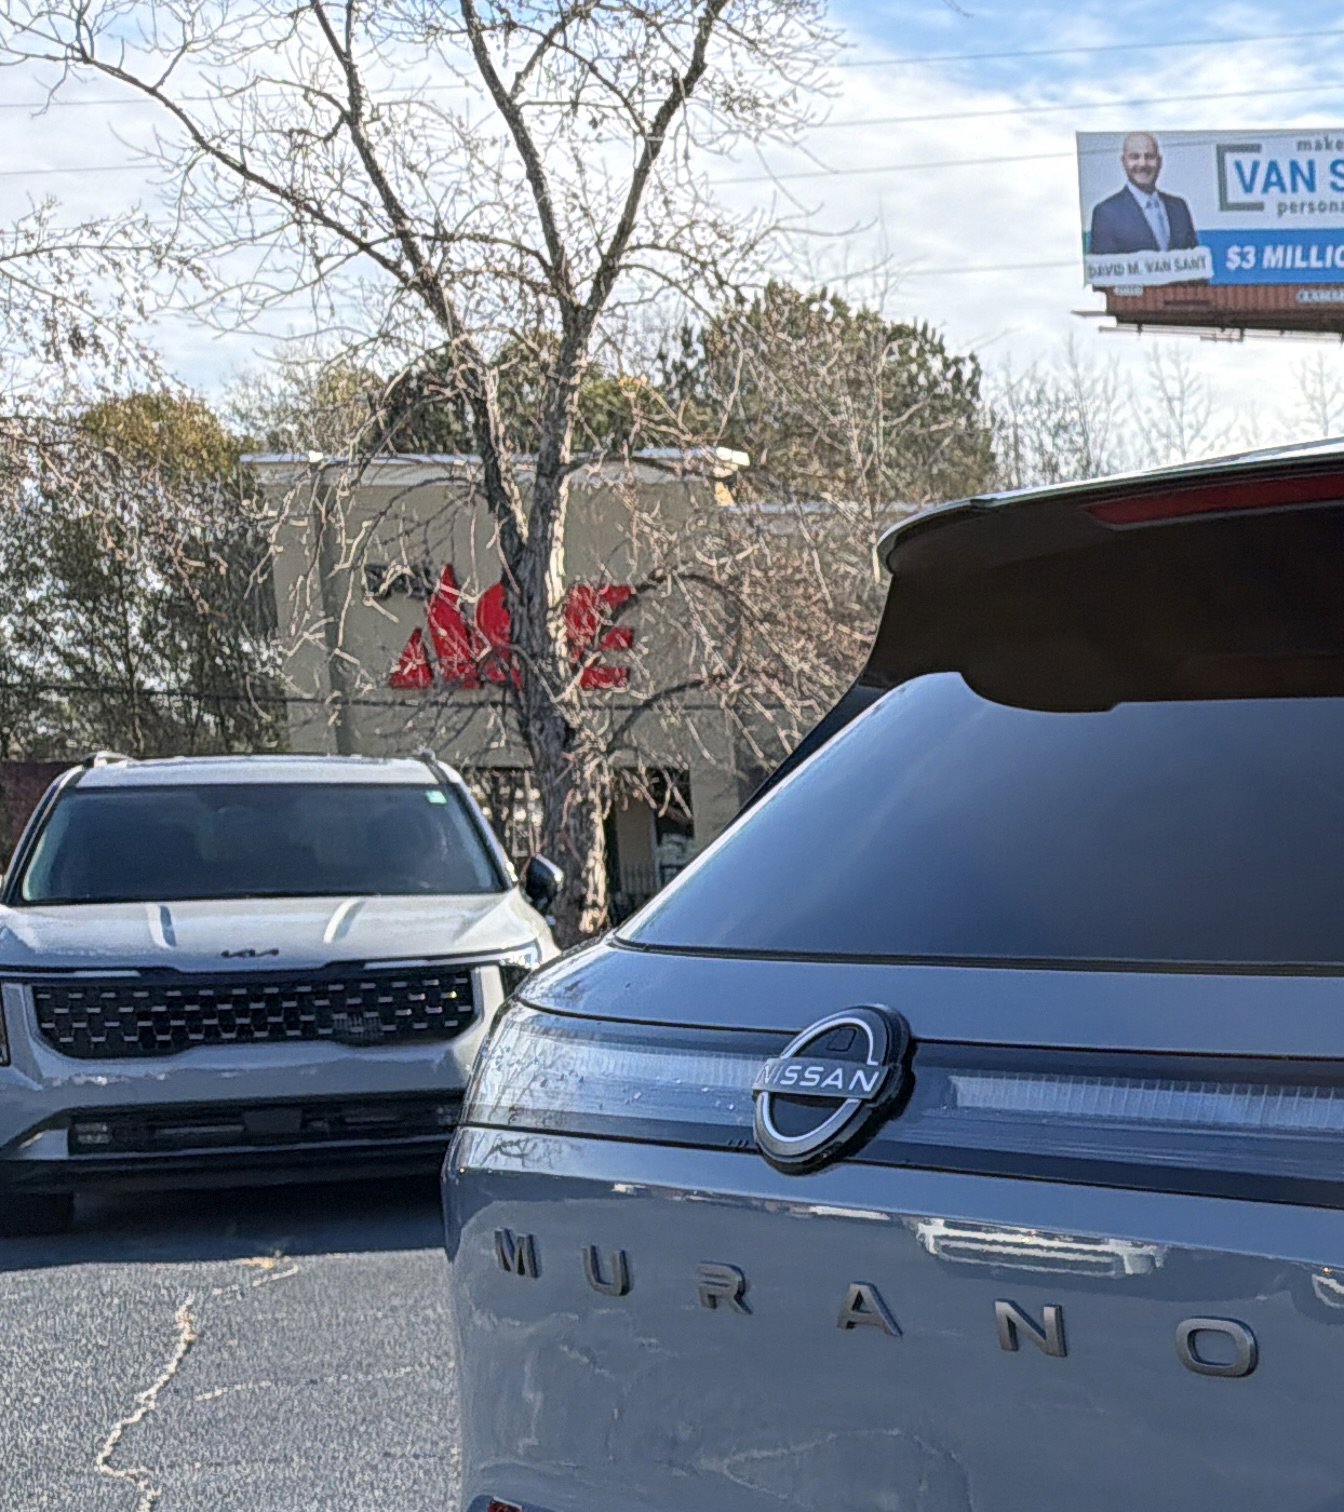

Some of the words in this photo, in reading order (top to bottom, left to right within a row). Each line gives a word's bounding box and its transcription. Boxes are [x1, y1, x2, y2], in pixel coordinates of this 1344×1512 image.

[1297, 135, 1344, 151] make
[1234, 159, 1317, 194] VAN
[1087, 263, 1125, 278] DAVID
[1144, 259, 1172, 273] VAN
[1174, 255, 1206, 271] SANT
[1225, 246, 1257, 271] $3
[757, 1065, 880, 1092] NISSAN
[494, 1227, 1260, 1378] MURANO
